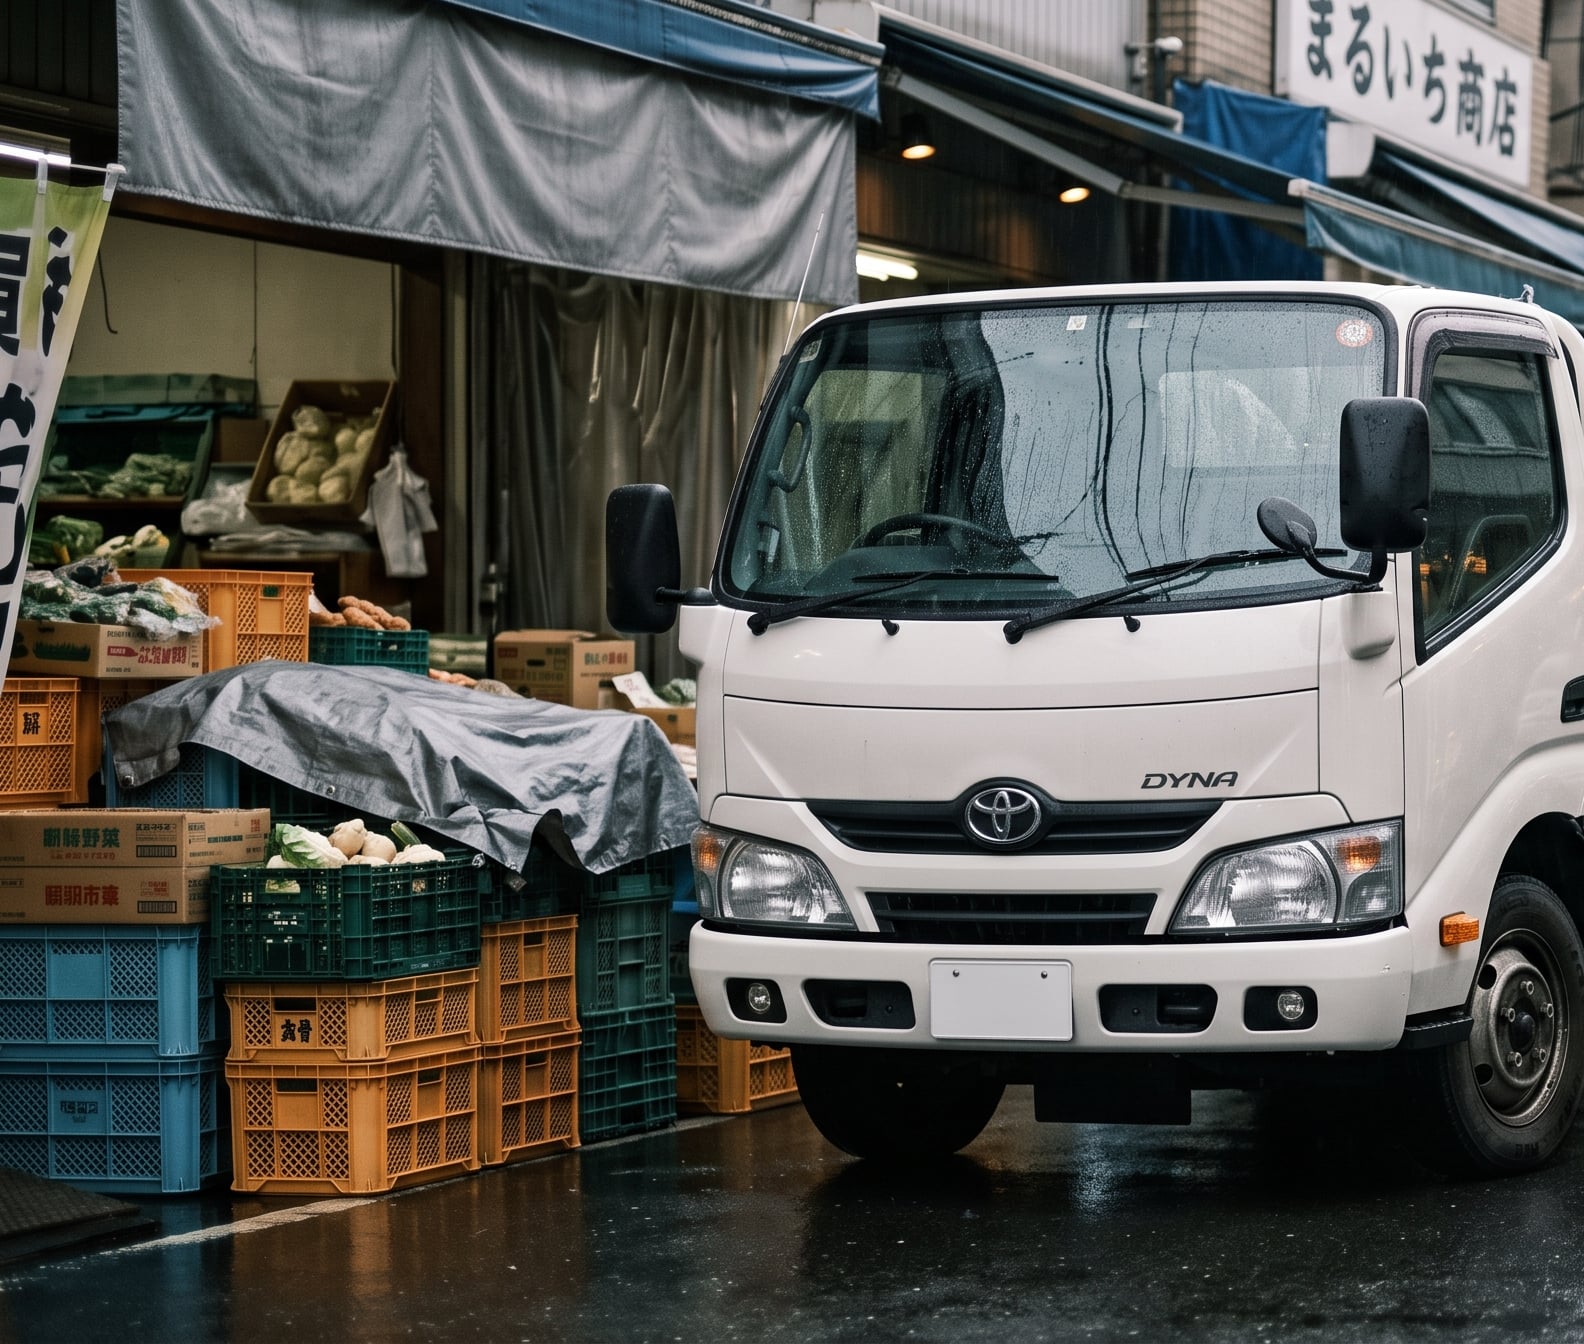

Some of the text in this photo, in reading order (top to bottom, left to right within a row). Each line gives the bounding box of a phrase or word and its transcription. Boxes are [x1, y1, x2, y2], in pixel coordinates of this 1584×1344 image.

[1308, 0, 1517, 157] まるいち商店
[1140, 771, 1239, 789] DYNA
